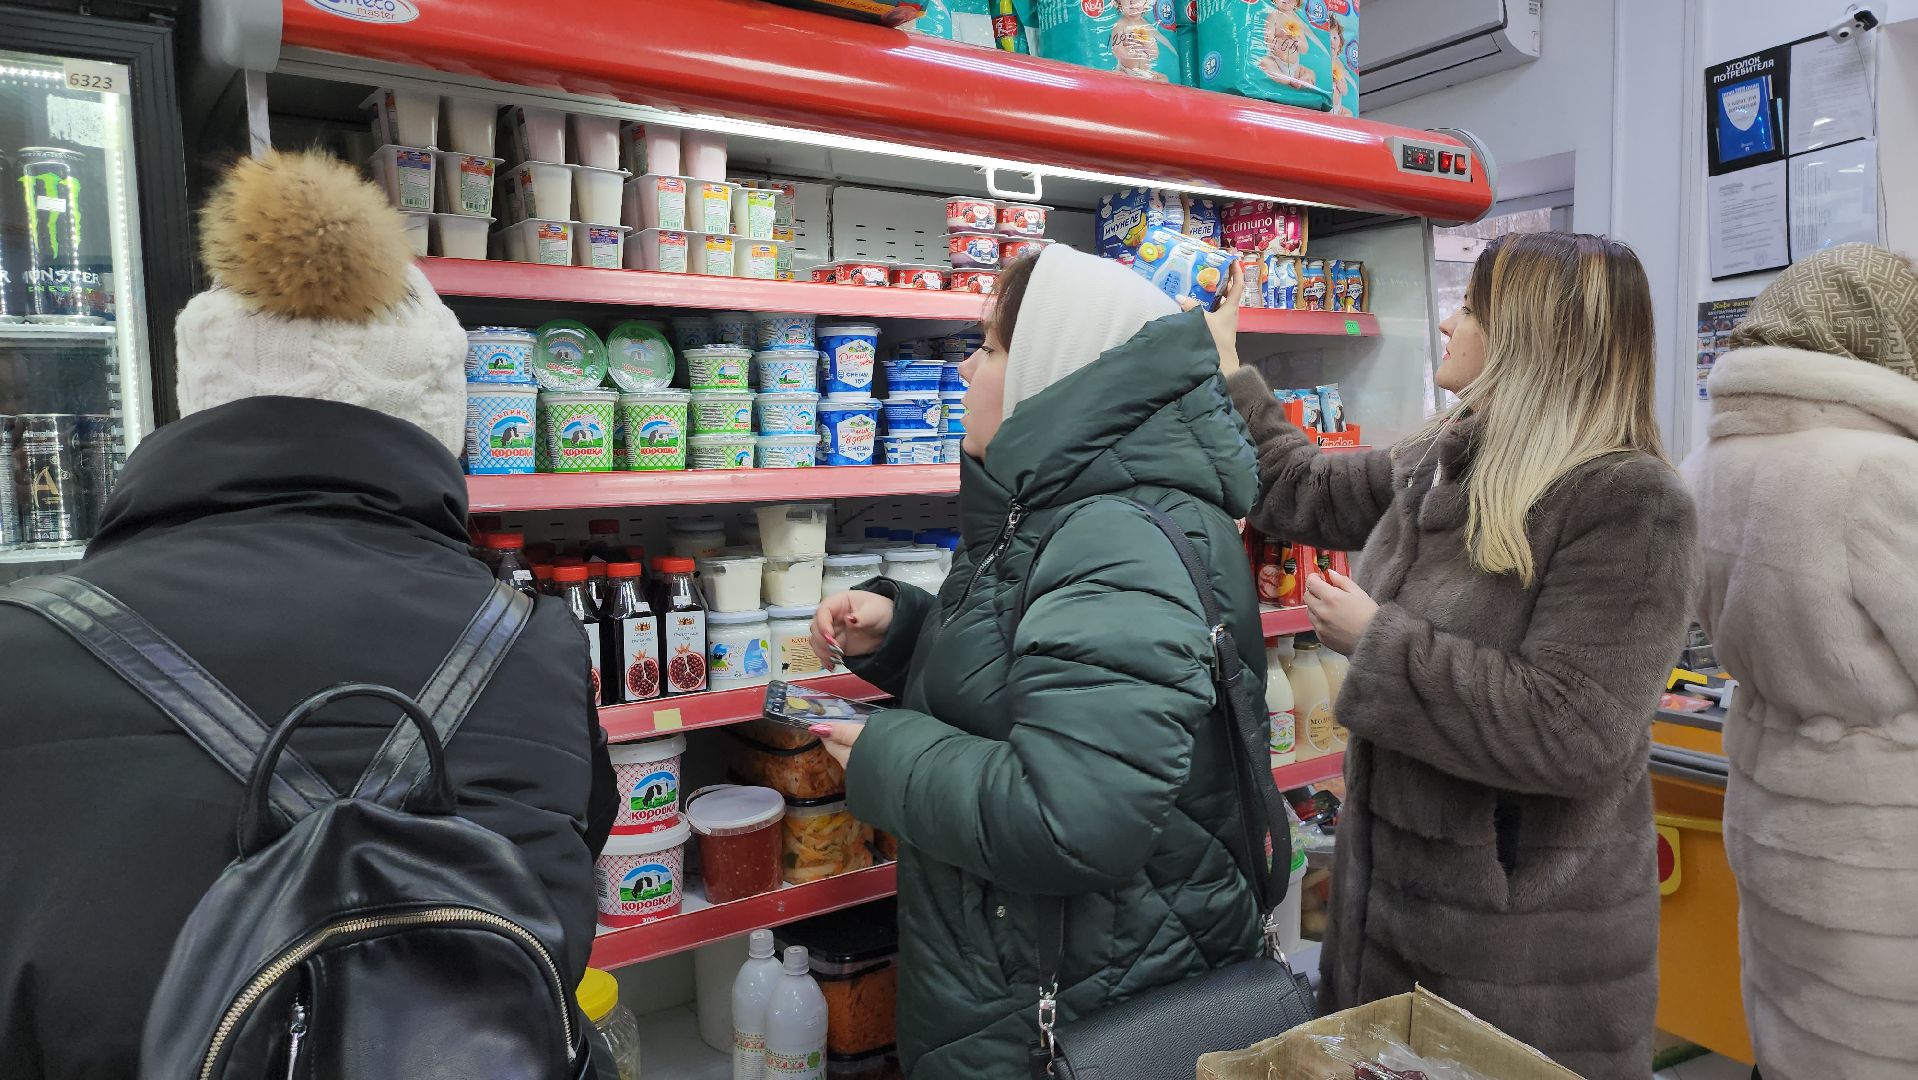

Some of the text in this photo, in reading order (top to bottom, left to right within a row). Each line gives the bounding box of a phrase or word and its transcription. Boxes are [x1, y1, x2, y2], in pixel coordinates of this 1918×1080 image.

[356, 7, 395, 20] master
[1713, 59, 1775, 83] ПОТРЕБИТЕЛЯ
[1726, 55, 1761, 73] УГОЛОК
[70, 73, 112, 90] 6323
[1221, 217, 1273, 234] Actimuno
[631, 804, 677, 820] КОРОВКА
[621, 895, 672, 912] КОРОВКА
